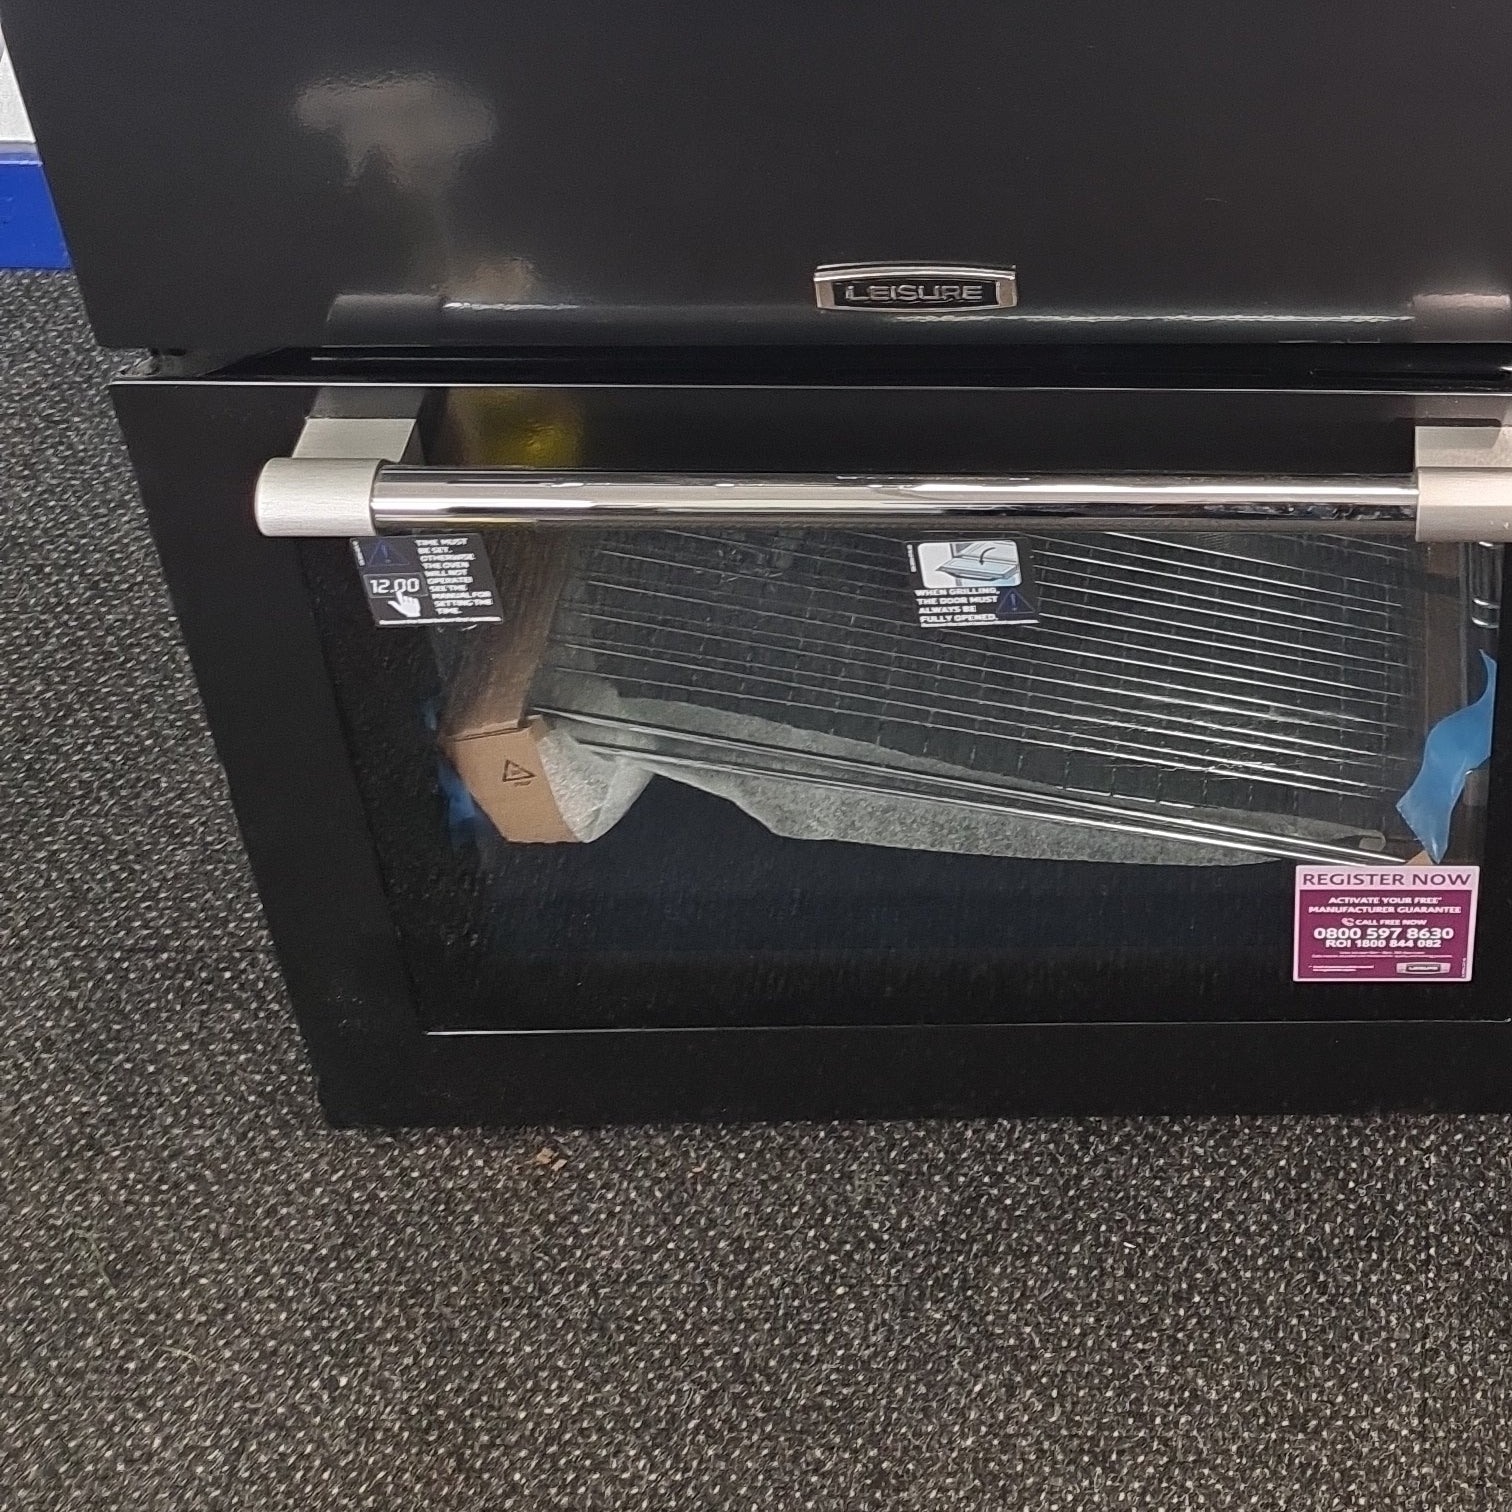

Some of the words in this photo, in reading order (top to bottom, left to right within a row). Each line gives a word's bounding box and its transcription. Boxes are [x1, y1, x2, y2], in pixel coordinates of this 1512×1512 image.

[845, 284, 983, 301] LEISURE
[369, 578, 420, 594] 12.00
[914, 589, 947, 597] WHEN
[916, 598, 939, 606] THE
[939, 597, 968, 605] DOOR
[969, 595, 998, 604] MUST
[918, 605, 961, 614] ALWAYS
[962, 605, 977, 613] BE
[919, 614, 953, 623] FULLY
[1303, 873, 1405, 886] REGISTER
[1412, 873, 1472, 886] NOW
[1328, 896, 1379, 904] ACTIVATE
[1382, 896, 1412, 904] YOUR
[1308, 906, 1396, 914] MANUFACTURER
[1397, 906, 1461, 914] GUARANTEE
[1313, 927, 1361, 939] 0800
[1366, 927, 1402, 939] 597
[1406, 927, 1454, 939] 8630
[1325, 939, 1351, 948] ROI
[1355, 939, 1386, 948] 1800
[1389, 939, 1414, 948] 844
[1416, 939, 1441, 948] 082
